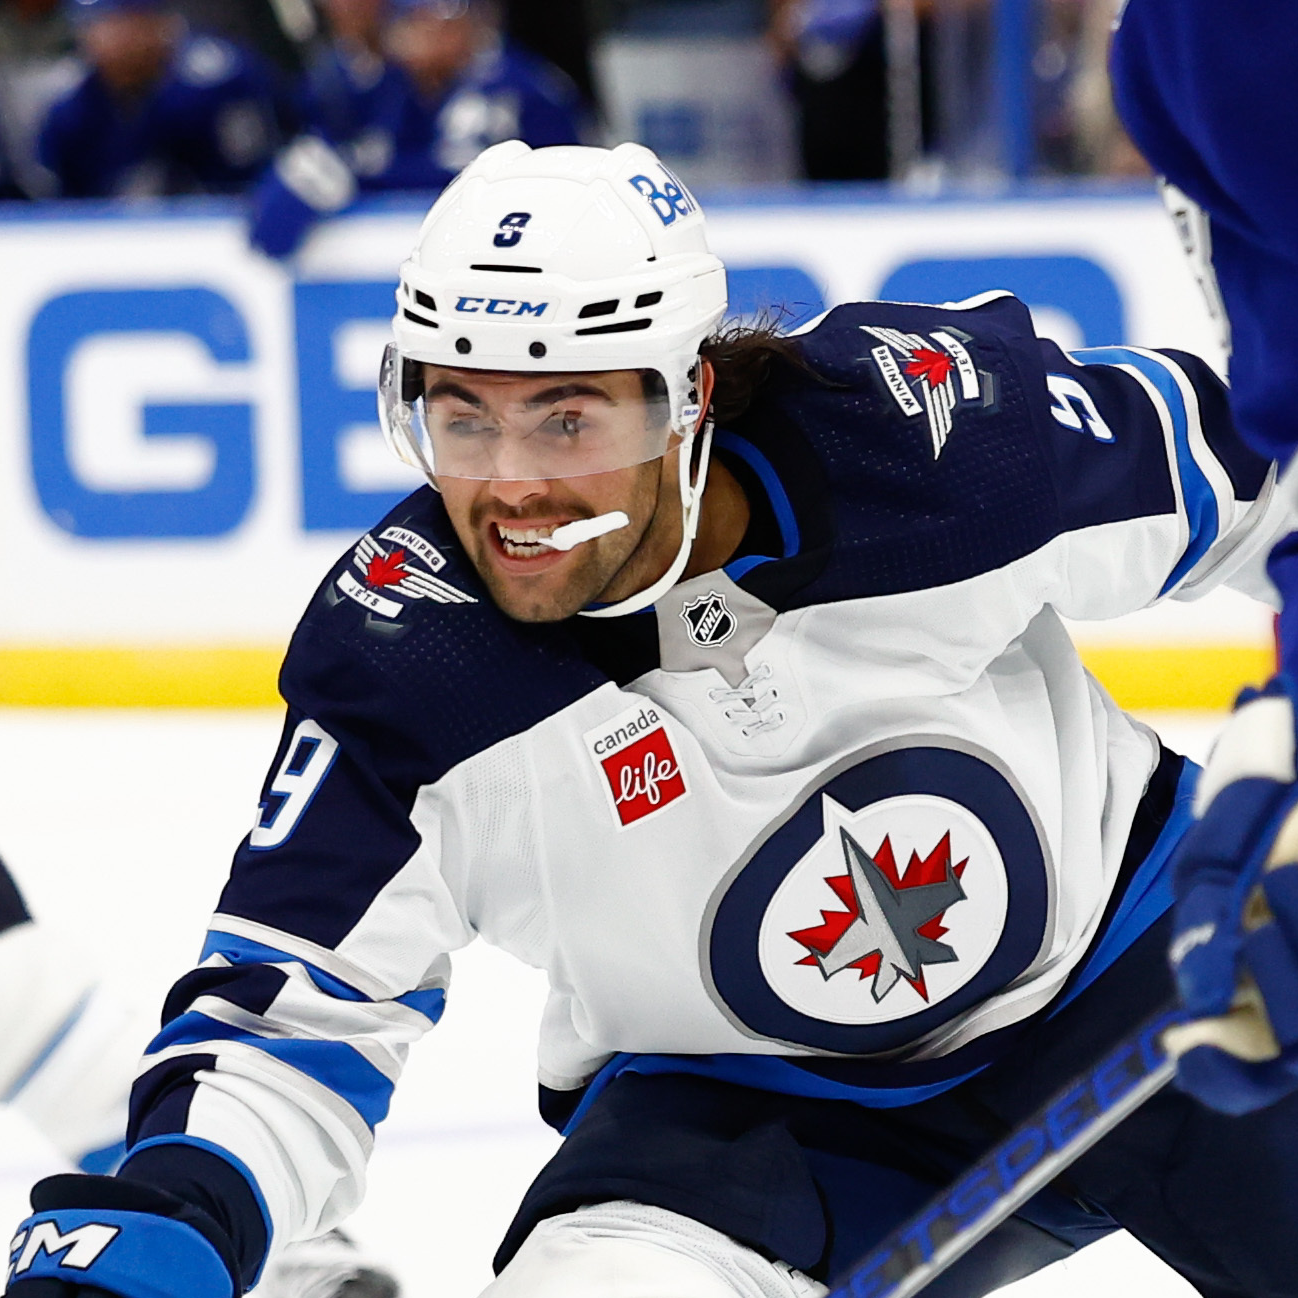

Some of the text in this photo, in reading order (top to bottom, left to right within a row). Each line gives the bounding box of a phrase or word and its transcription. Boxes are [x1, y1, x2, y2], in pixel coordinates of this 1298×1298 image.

[492, 211, 532, 248] 9
[454, 296, 550, 318] CCM
[948, 342, 973, 376] JETS
[876, 347, 916, 411] WINNIPEG
[386, 529, 441, 567] WINNIPEG
[348, 585, 380, 607] JETS
[698, 604, 724, 641] NHL
[592, 706, 661, 756] canada
[248, 718, 342, 852] 9
[615, 751, 681, 806] life
